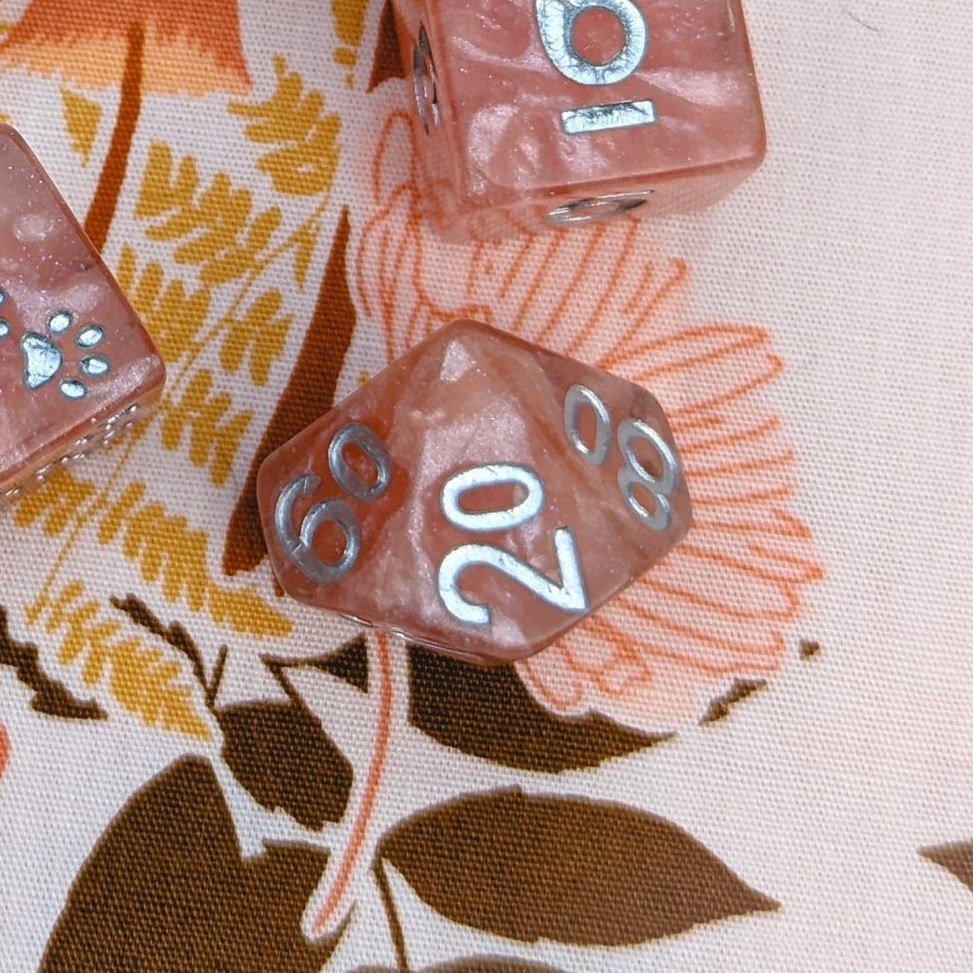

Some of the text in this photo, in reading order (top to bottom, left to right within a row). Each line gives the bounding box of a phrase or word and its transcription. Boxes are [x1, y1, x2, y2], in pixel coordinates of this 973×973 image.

[274, 423, 391, 584] 60
[564, 384, 678, 530] 80
[437, 462, 589, 625] 20
